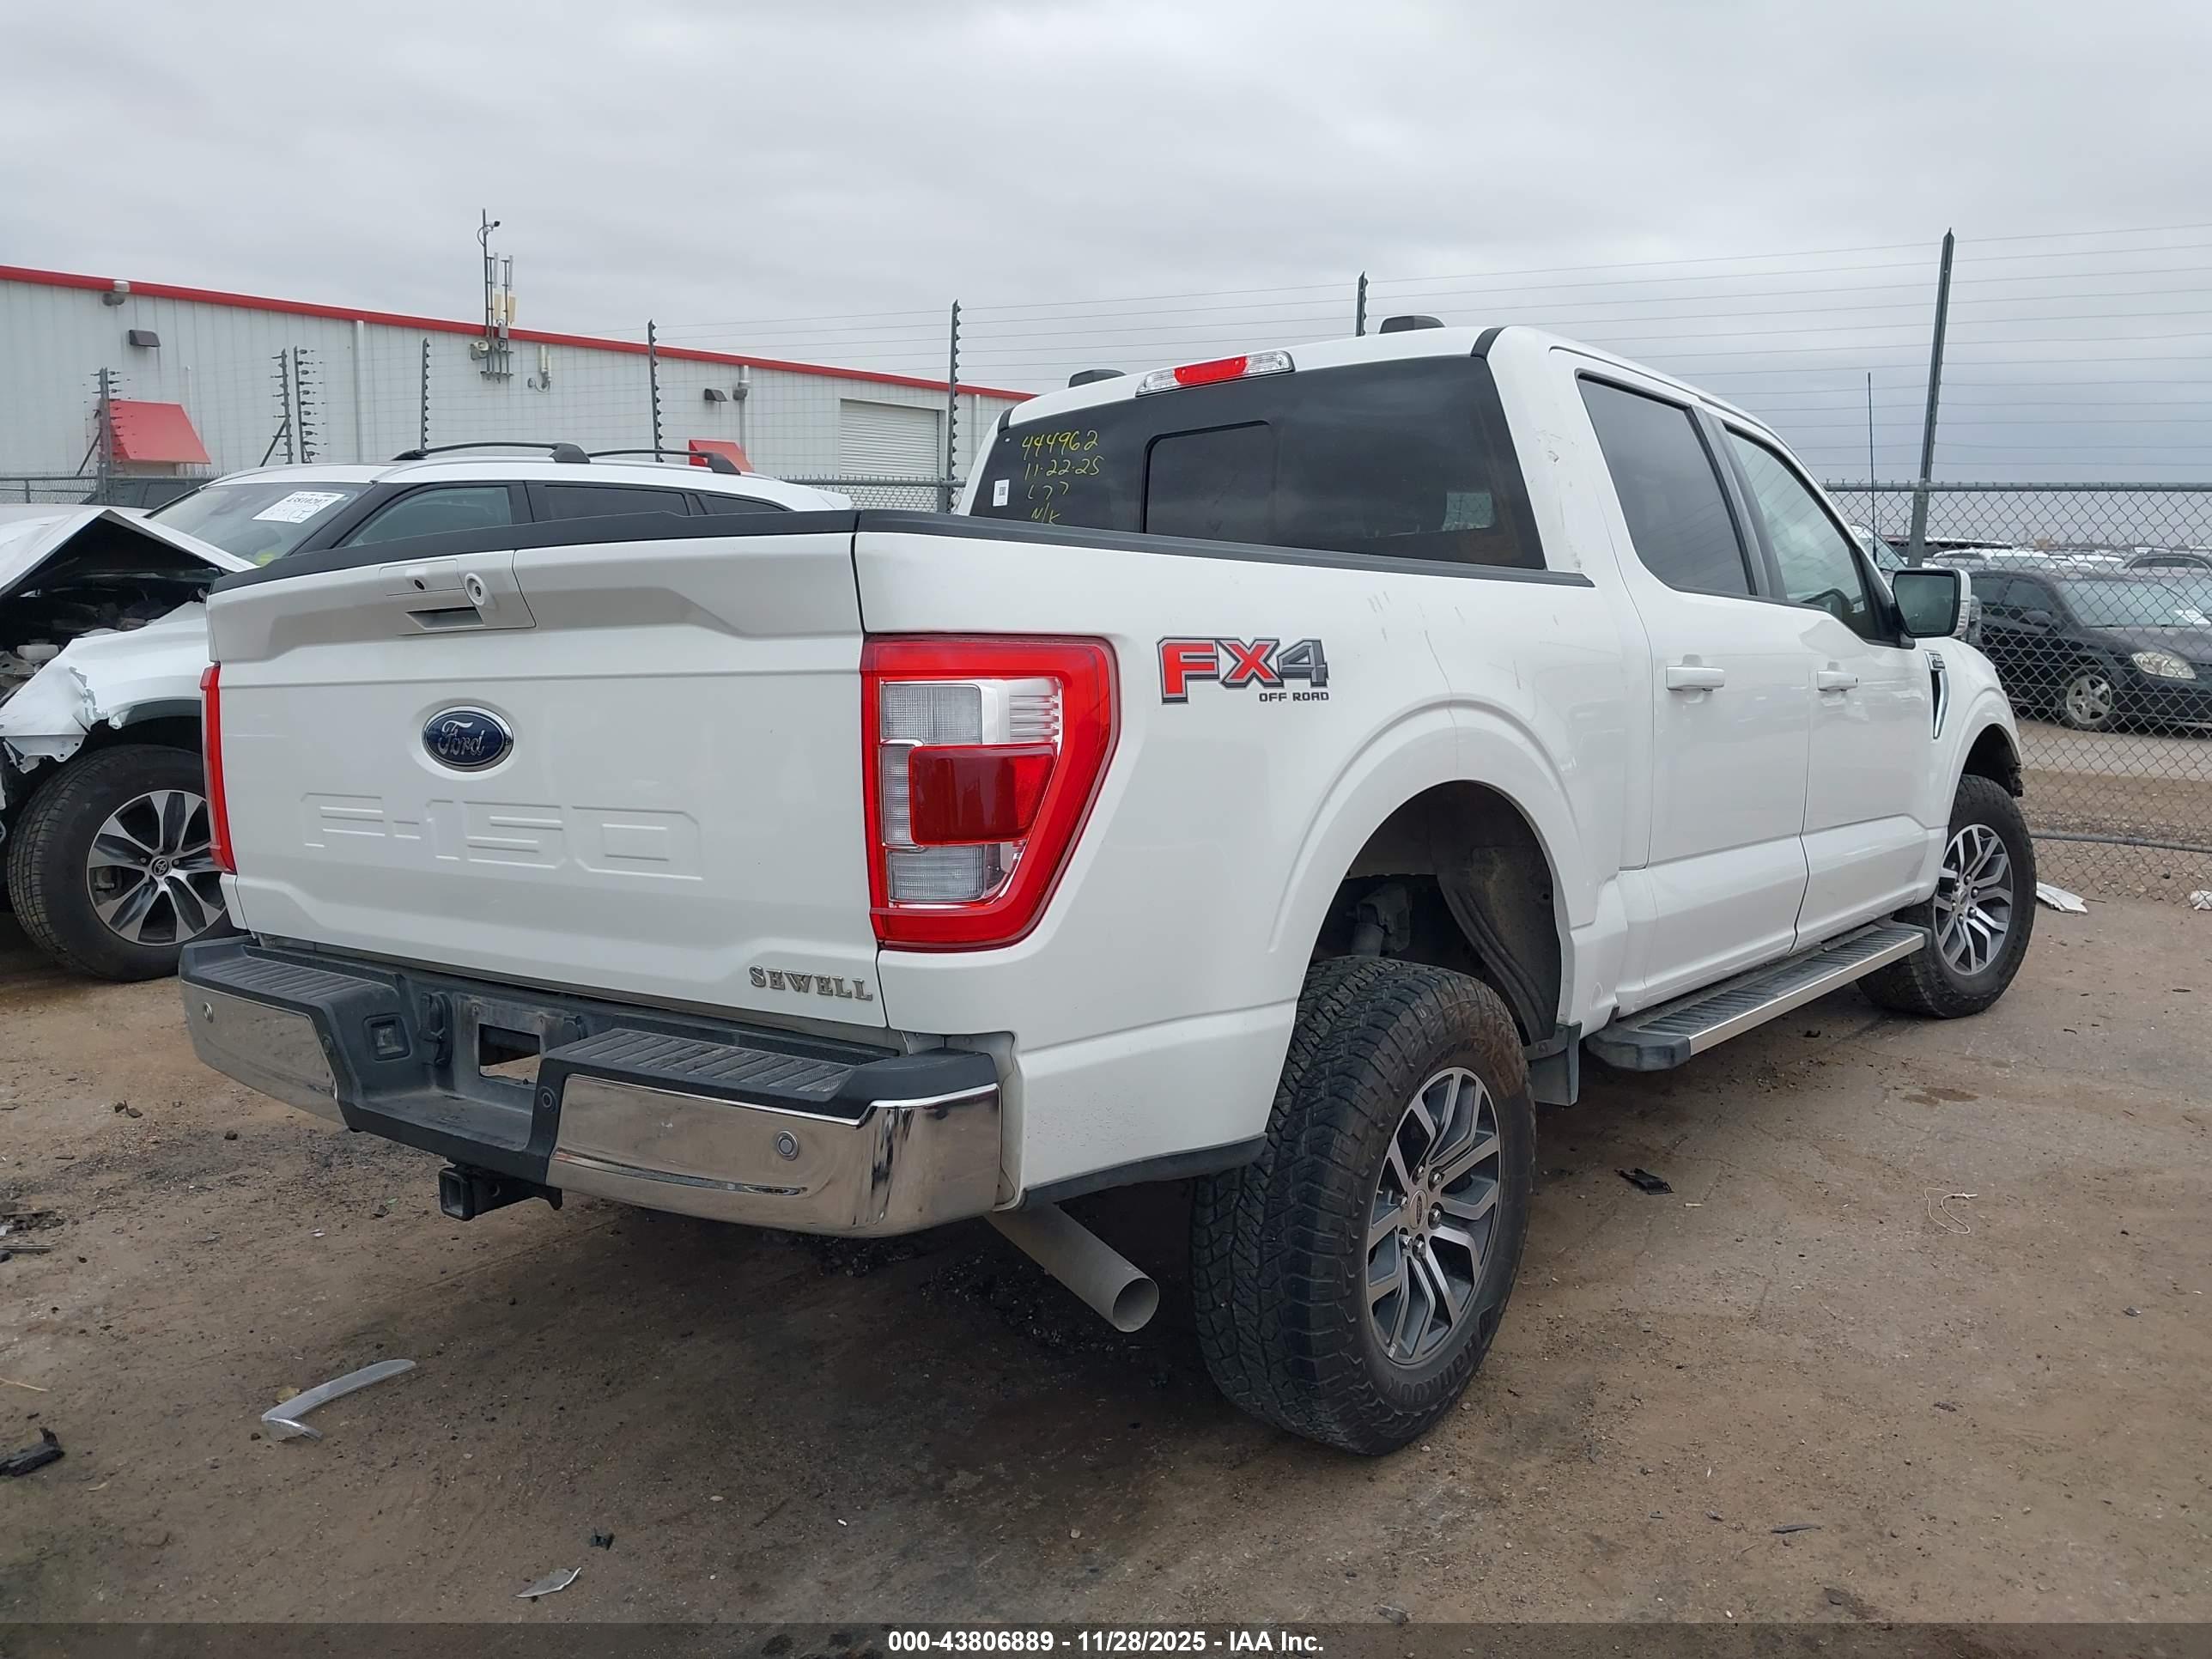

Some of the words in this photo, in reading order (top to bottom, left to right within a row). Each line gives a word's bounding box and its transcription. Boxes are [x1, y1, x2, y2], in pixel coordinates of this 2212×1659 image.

[1022, 429, 1098, 460] 444962
[1157, 635, 1328, 705] FX4
[1259, 692, 1287, 702] OFF
[1292, 691, 1329, 702] ROAD
[437, 720, 486, 757] Ford
[301, 792, 703, 880] F-150
[749, 964, 873, 1001] SEWELL
